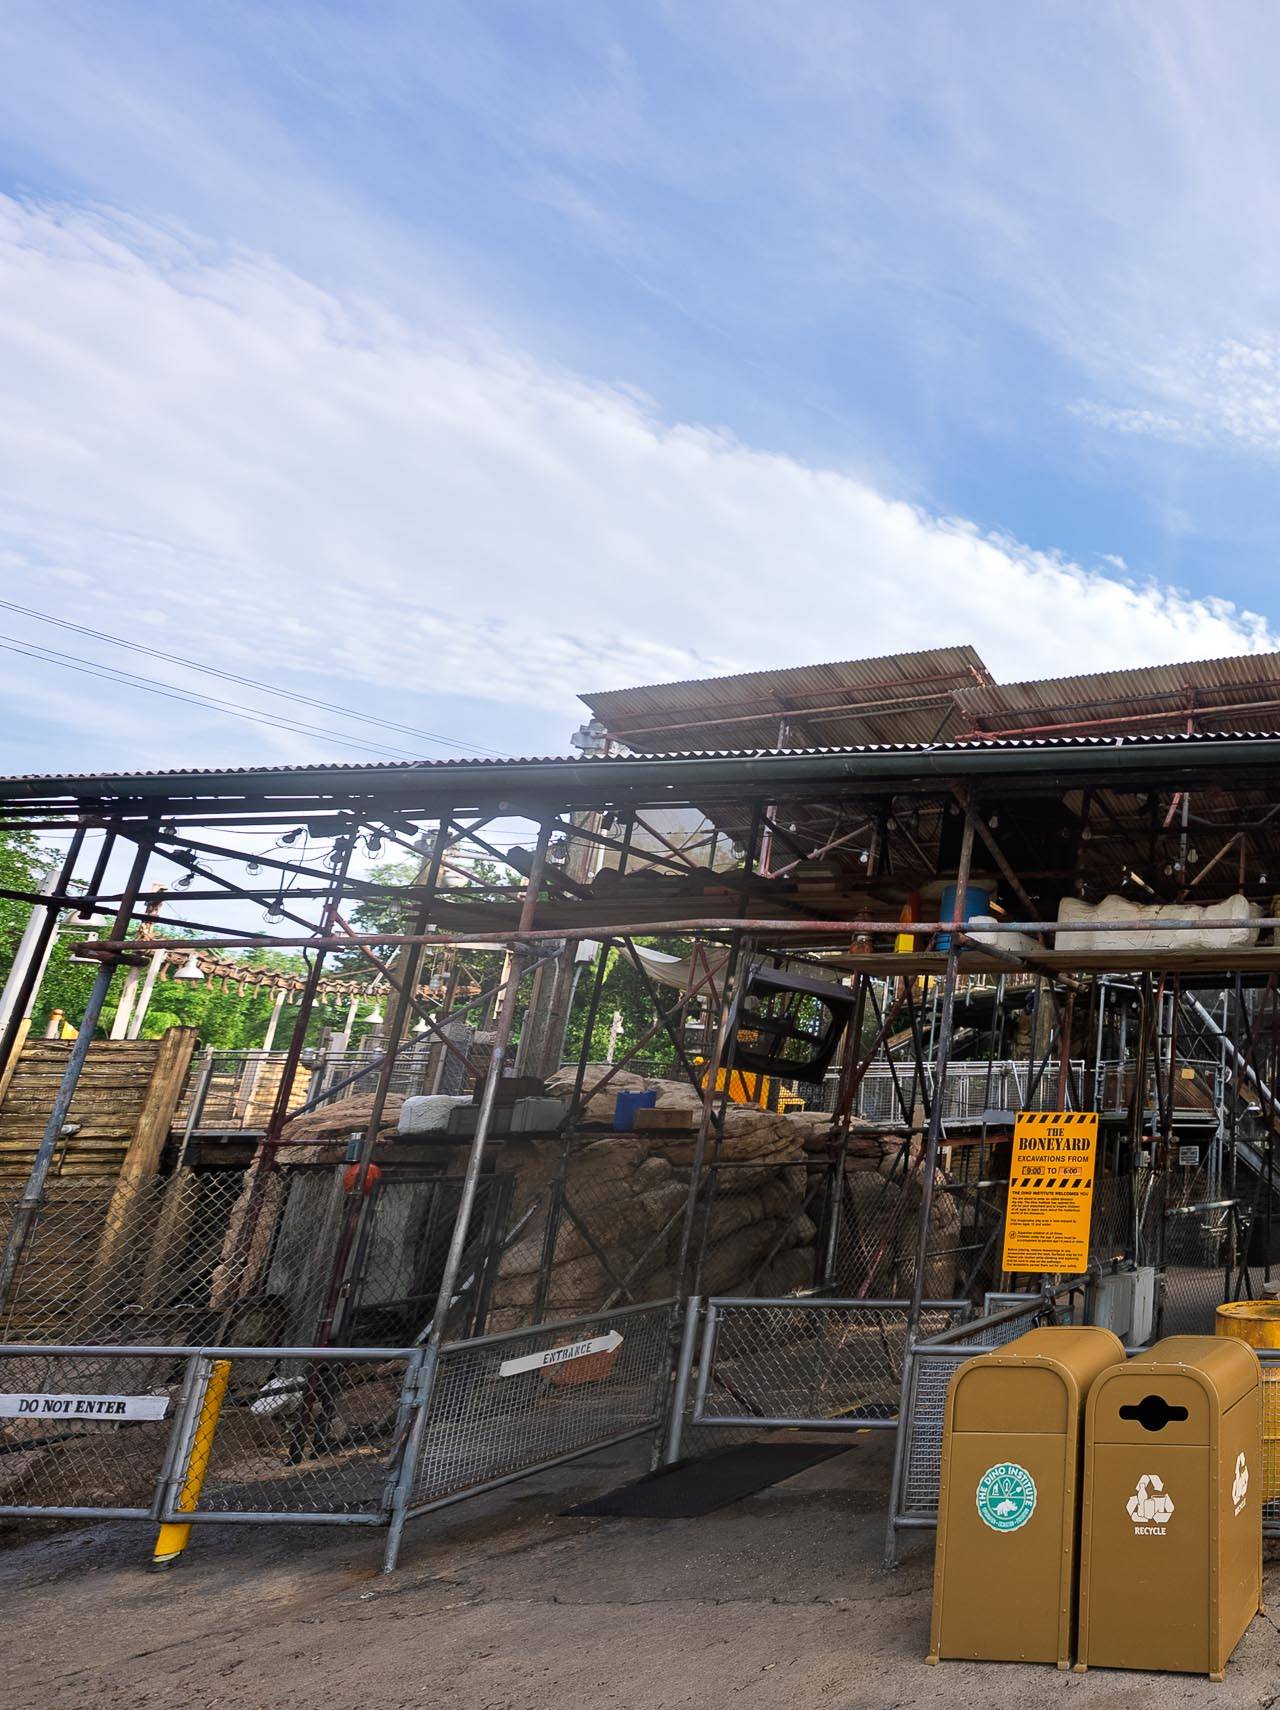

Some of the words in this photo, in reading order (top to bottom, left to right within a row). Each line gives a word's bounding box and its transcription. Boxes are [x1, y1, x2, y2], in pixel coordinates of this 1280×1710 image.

[1046, 1127, 1065, 1136] THE
[1018, 1137, 1091, 1151] BONEYARD
[1017, 1155, 1066, 1163] EXCAVATIONS
[1067, 1155, 1089, 1163] FROM
[1047, 1167, 1057, 1175] TO
[542, 1342, 593, 1365] ENTRANCE
[18, 1399, 39, 1412] DO
[42, 1400, 73, 1413] NOT
[74, 1400, 126, 1414] ENTER
[978, 1486, 988, 1507] THE
[984, 1466, 1006, 1485] DINO
[1008, 1466, 1034, 1507] INSTITUTE
[1134, 1526, 1167, 1536] RECYCLE
